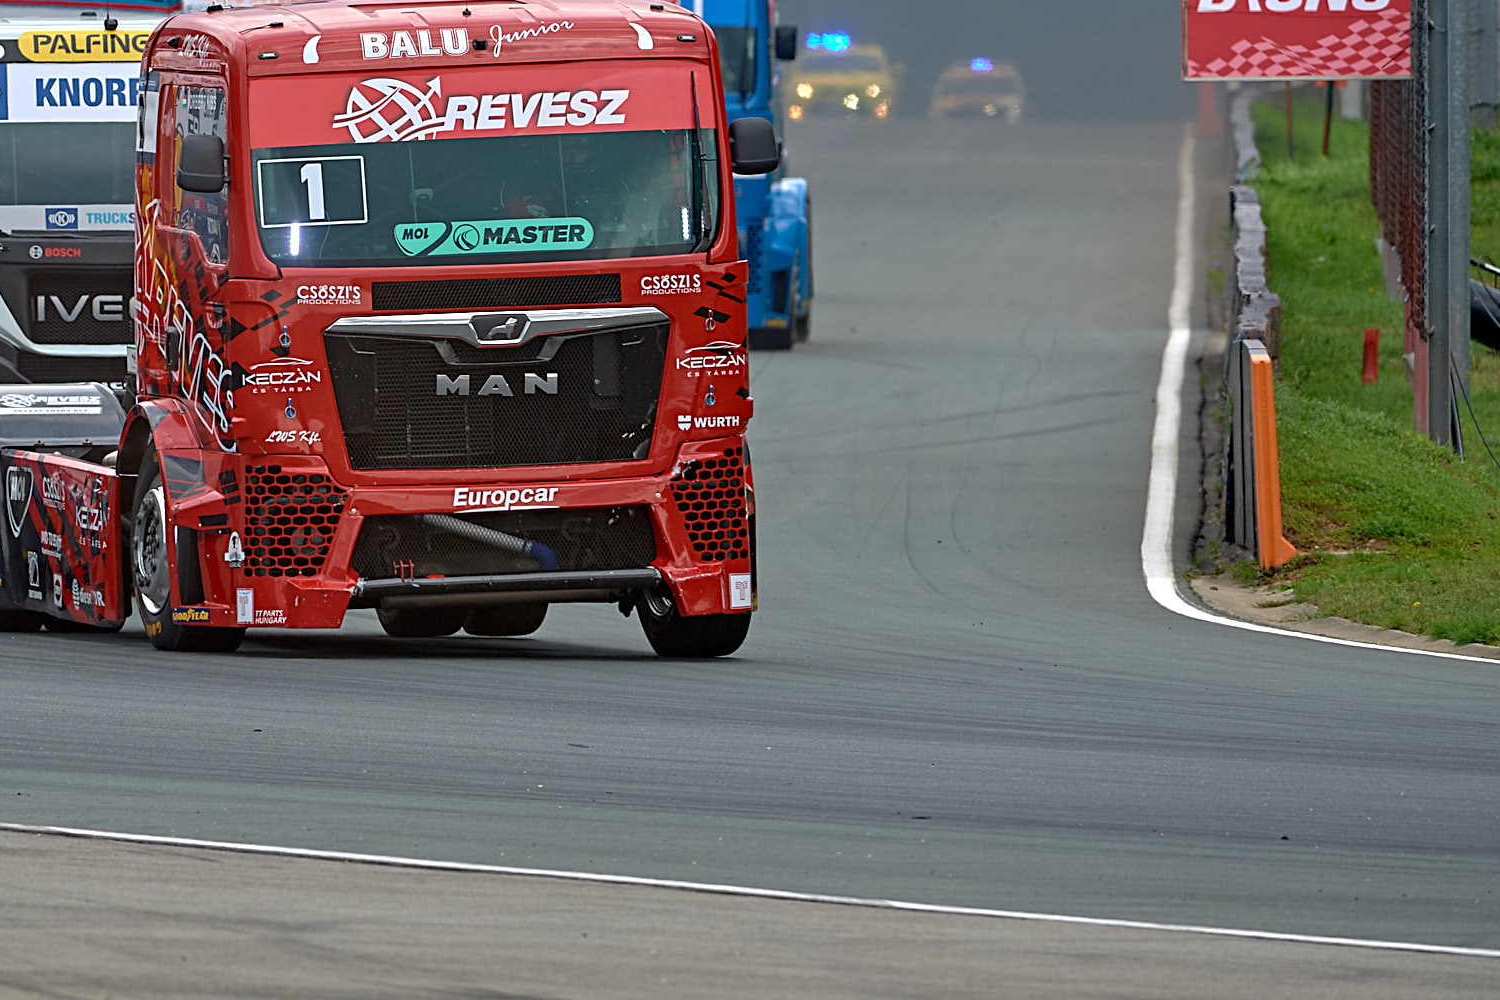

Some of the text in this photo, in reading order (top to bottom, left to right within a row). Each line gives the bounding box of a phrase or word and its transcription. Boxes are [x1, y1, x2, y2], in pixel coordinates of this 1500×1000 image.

[33, 34, 149, 54] PALFING
[360, 20, 574, 59] BALU Junior
[441, 90, 630, 131] REVESZ
[300, 162, 326, 220] 1
[483, 224, 586, 246] MASTER
[44, 247, 82, 258] BOSCH
[641, 287, 702, 296] PRODUCTIONS
[436, 372, 559, 397] MAN
[694, 416, 740, 429] WÜRTH
[265, 430, 322, 445] LWS Kft.
[453, 487, 559, 510] Europcar
[255, 616, 287, 625] HUNGARY
[263, 609, 284, 618] PARTS
